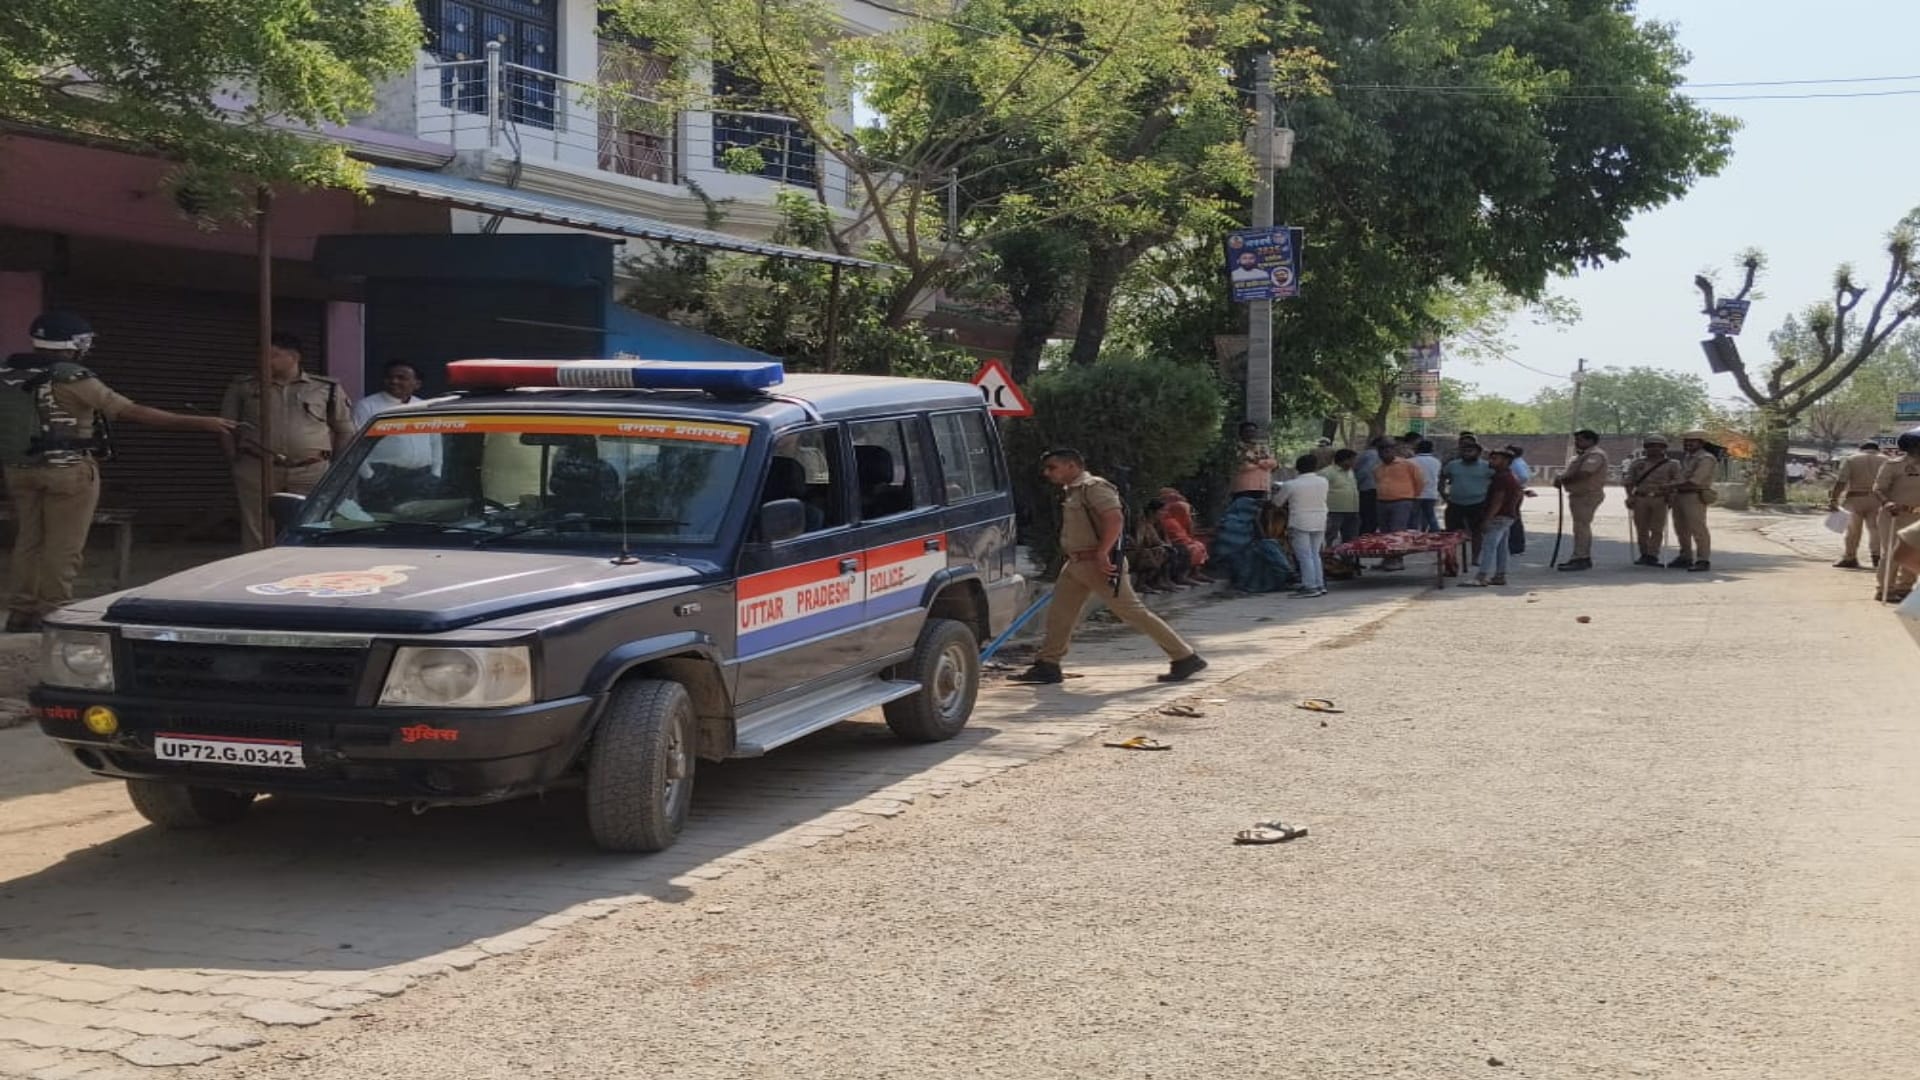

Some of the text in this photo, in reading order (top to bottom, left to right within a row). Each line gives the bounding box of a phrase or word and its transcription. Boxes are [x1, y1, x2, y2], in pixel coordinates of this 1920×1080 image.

[740, 566, 905, 629] UTTAR PRADESH POLICE
[401, 724, 459, 743] पुलिस
[162, 742, 296, 766] UP72.G.0342
